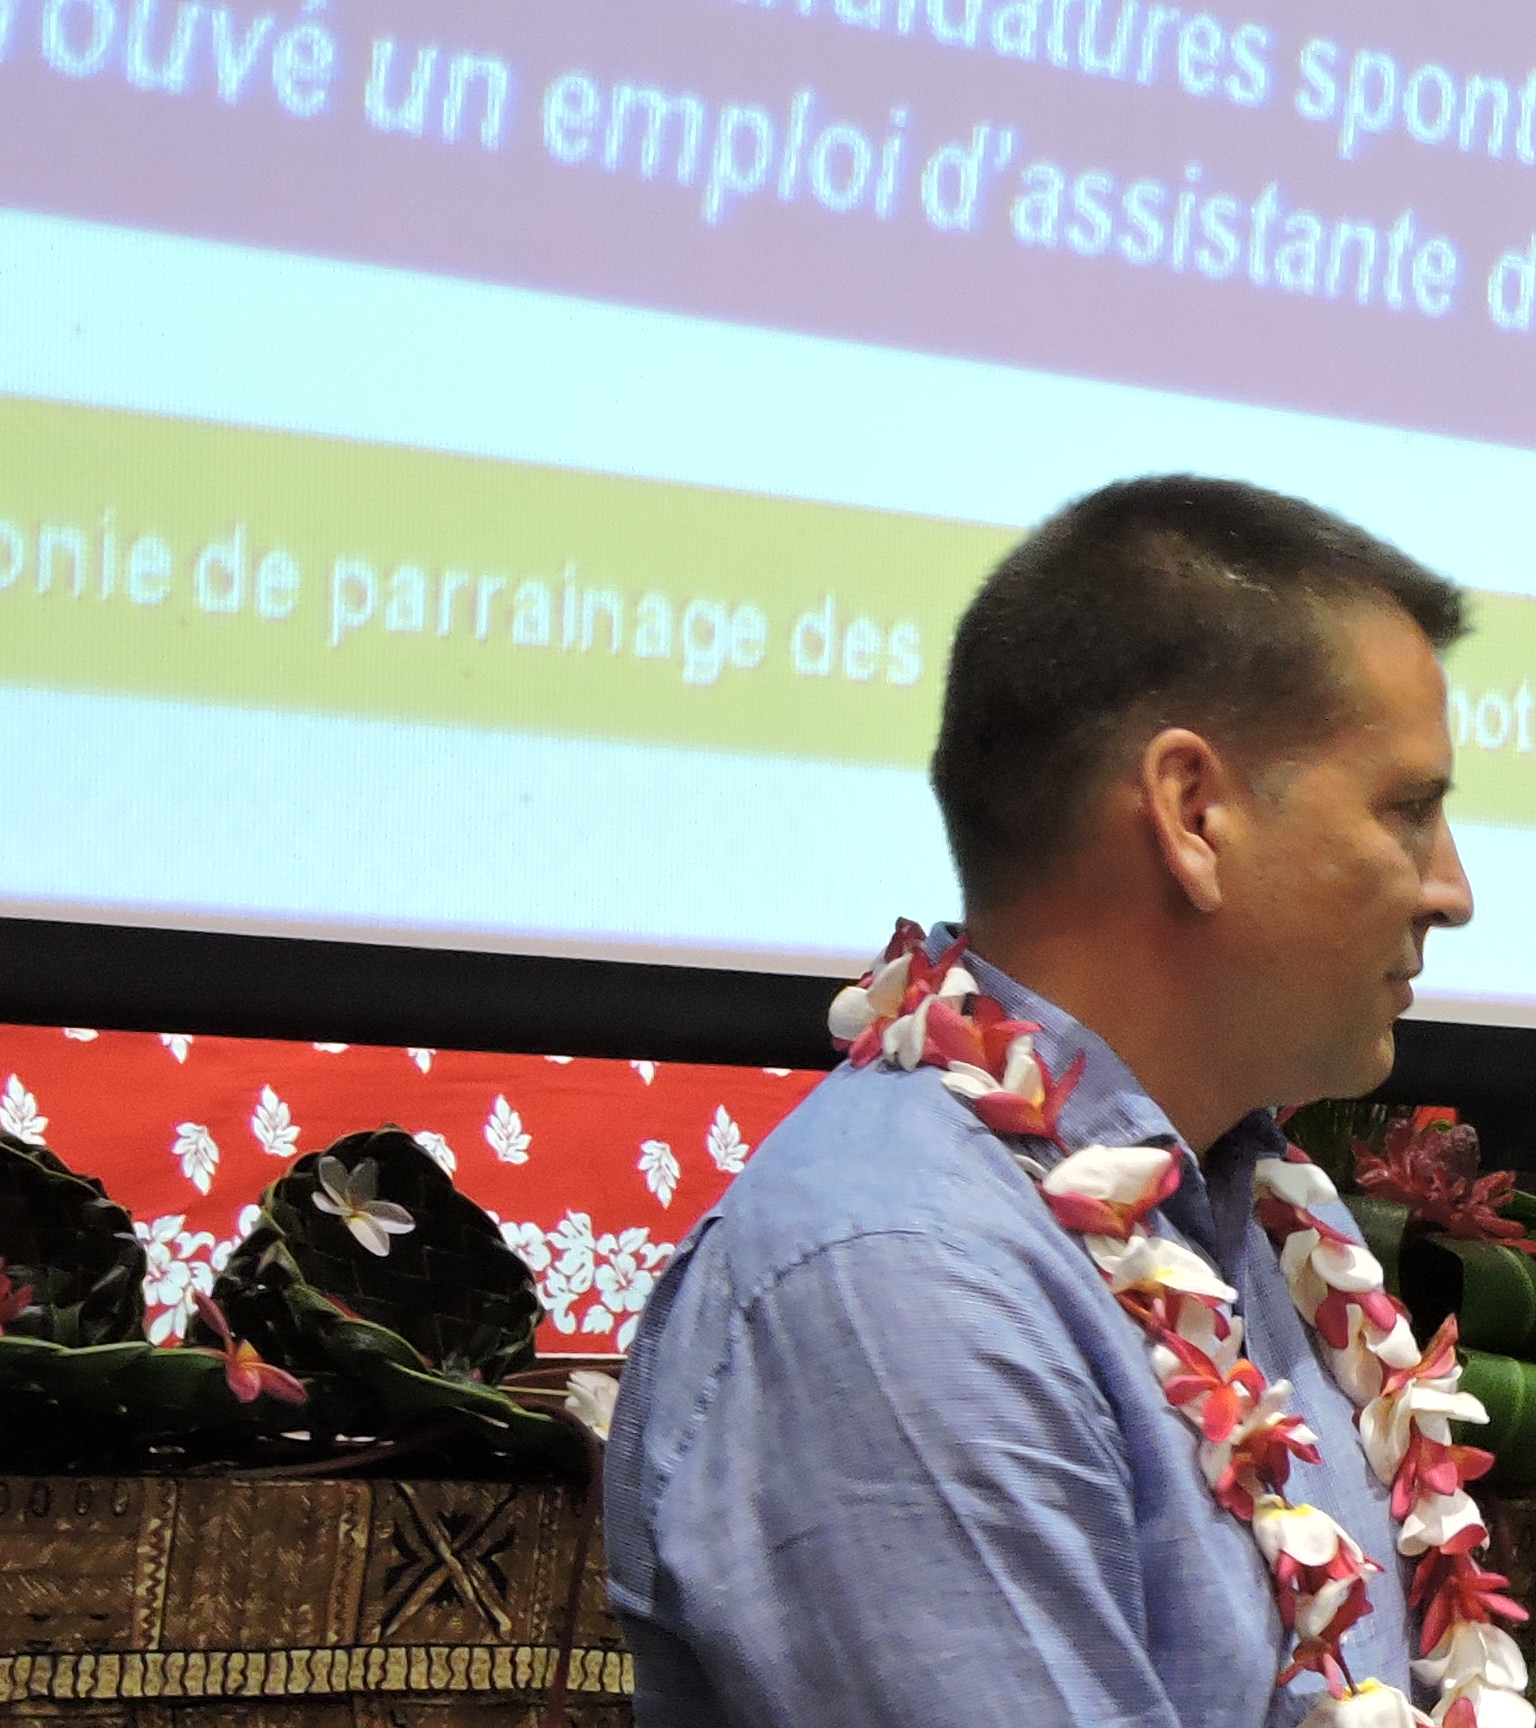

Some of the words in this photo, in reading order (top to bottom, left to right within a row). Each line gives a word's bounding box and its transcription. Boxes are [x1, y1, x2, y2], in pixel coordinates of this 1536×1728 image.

[365, 38, 512, 150] un
[542, 69, 908, 226] emploi
[920, 120, 1460, 318] d'assistante
[194, 522, 300, 618] de
[330, 556, 767, 686] parrainage
[790, 592, 925, 688] des
